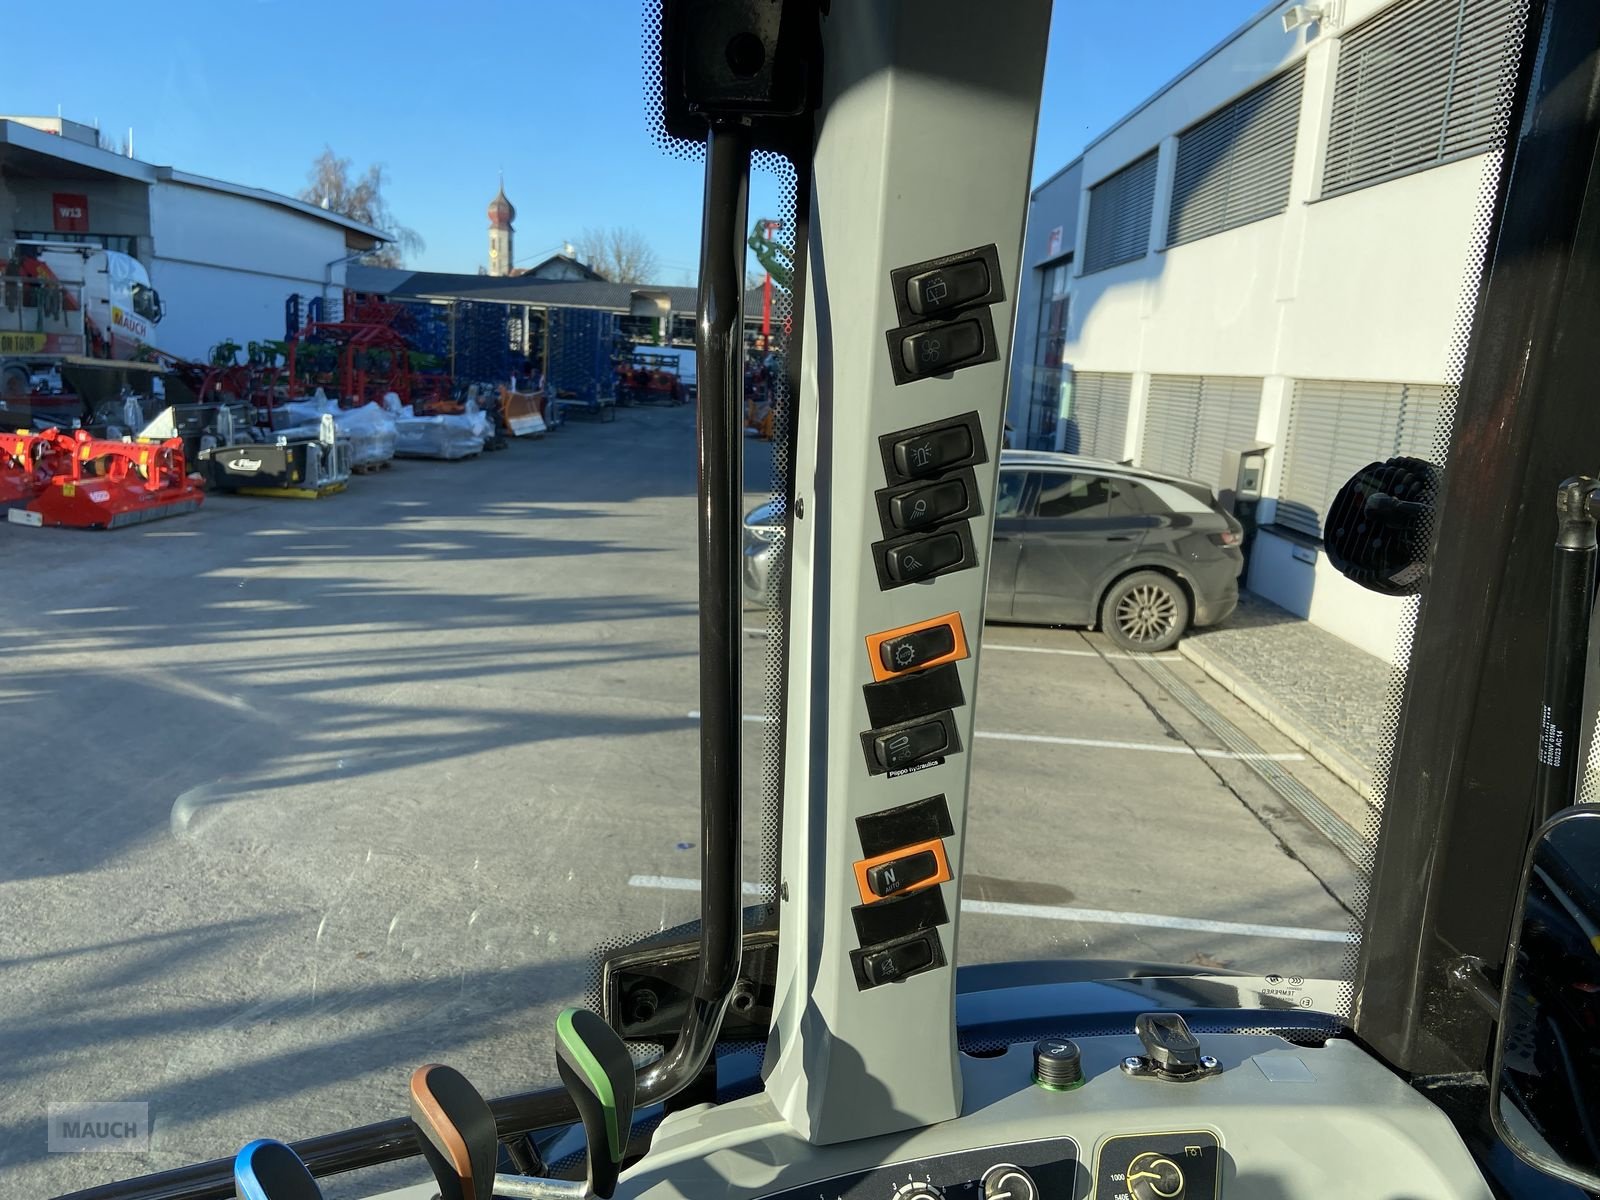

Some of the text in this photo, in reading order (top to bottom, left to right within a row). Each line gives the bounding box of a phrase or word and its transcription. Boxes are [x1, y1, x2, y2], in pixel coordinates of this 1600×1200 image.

[59, 207, 82, 218] W13
[114, 310, 147, 337] MAUCH
[884, 868, 896, 885] N
[926, 1174, 931, 1182] 5
[1110, 1173, 1126, 1181] 1000
